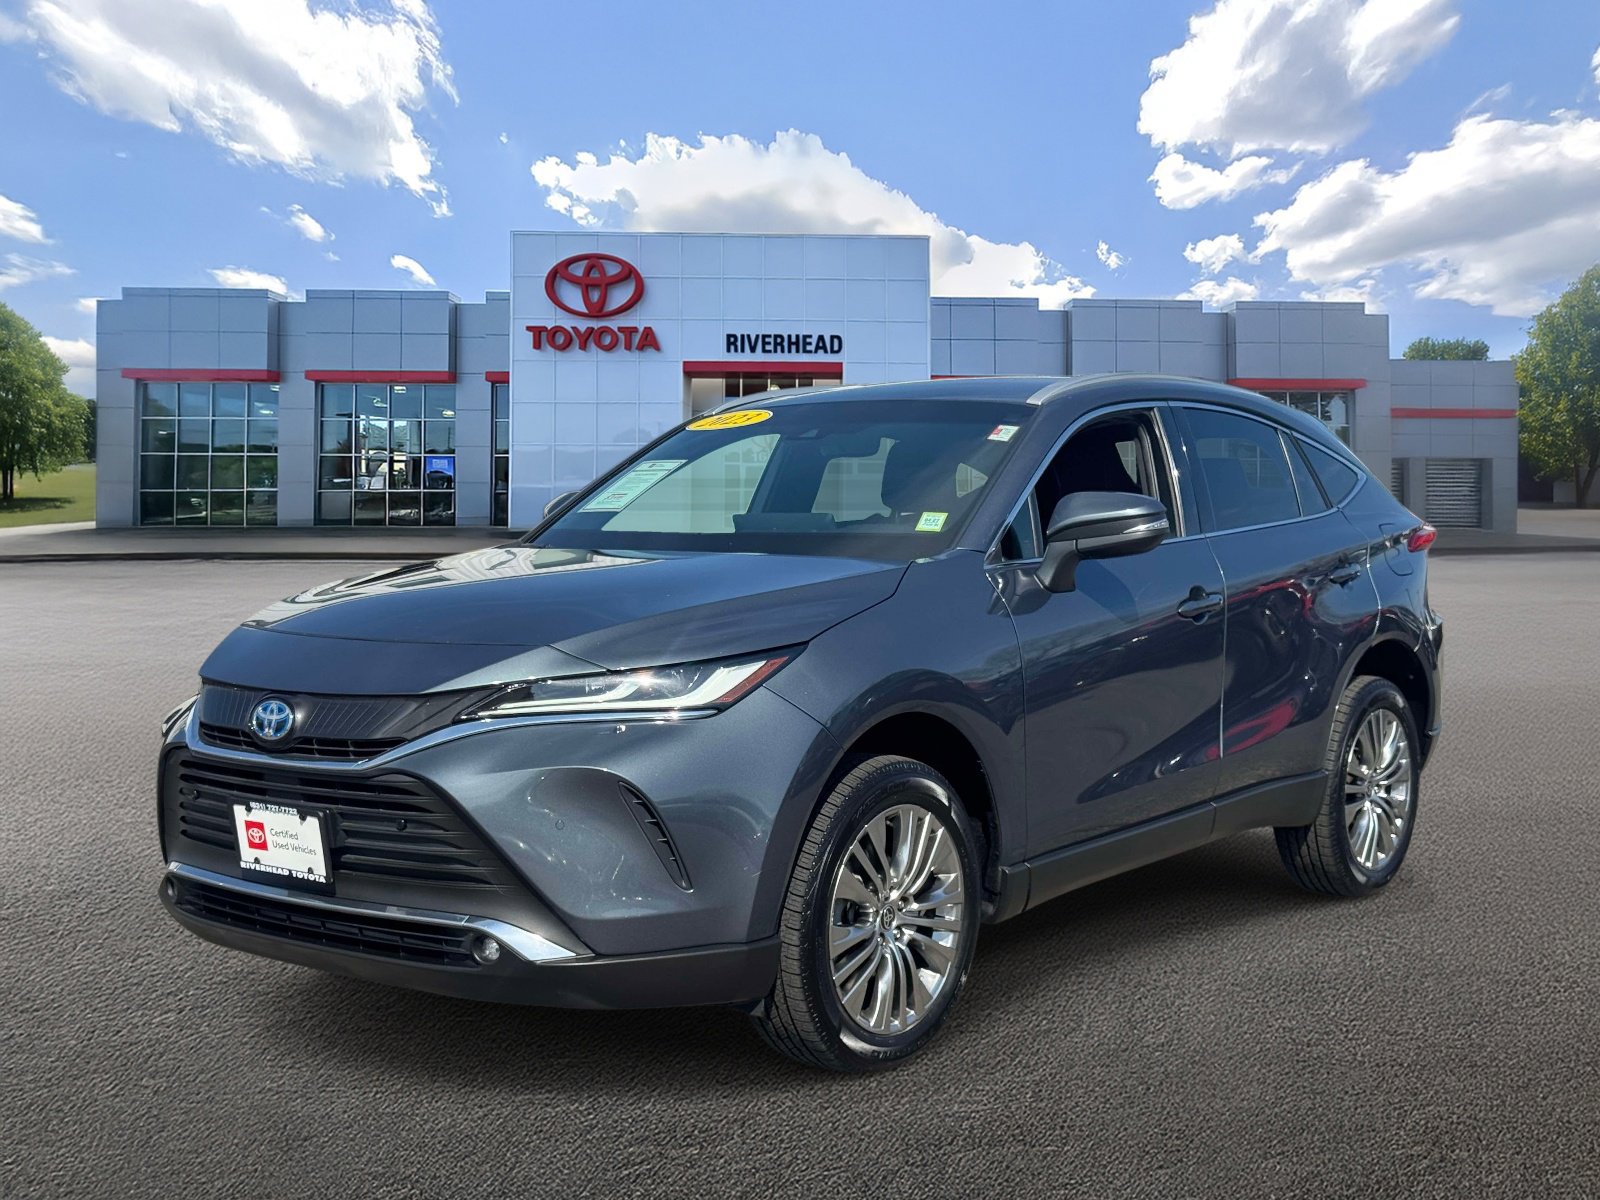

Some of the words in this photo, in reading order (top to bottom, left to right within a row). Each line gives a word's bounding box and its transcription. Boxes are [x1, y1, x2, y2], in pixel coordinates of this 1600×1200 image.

[525, 325, 661, 352] TOYOTA
[726, 333, 843, 354] RIVERHEAD
[270, 828, 298, 840] Certified
[272, 840, 289, 850] Used
[290, 844, 316, 855] Vehicles
[240, 861, 289, 875] RIVERHEAD
[291, 871, 326, 883] TOYOTA
